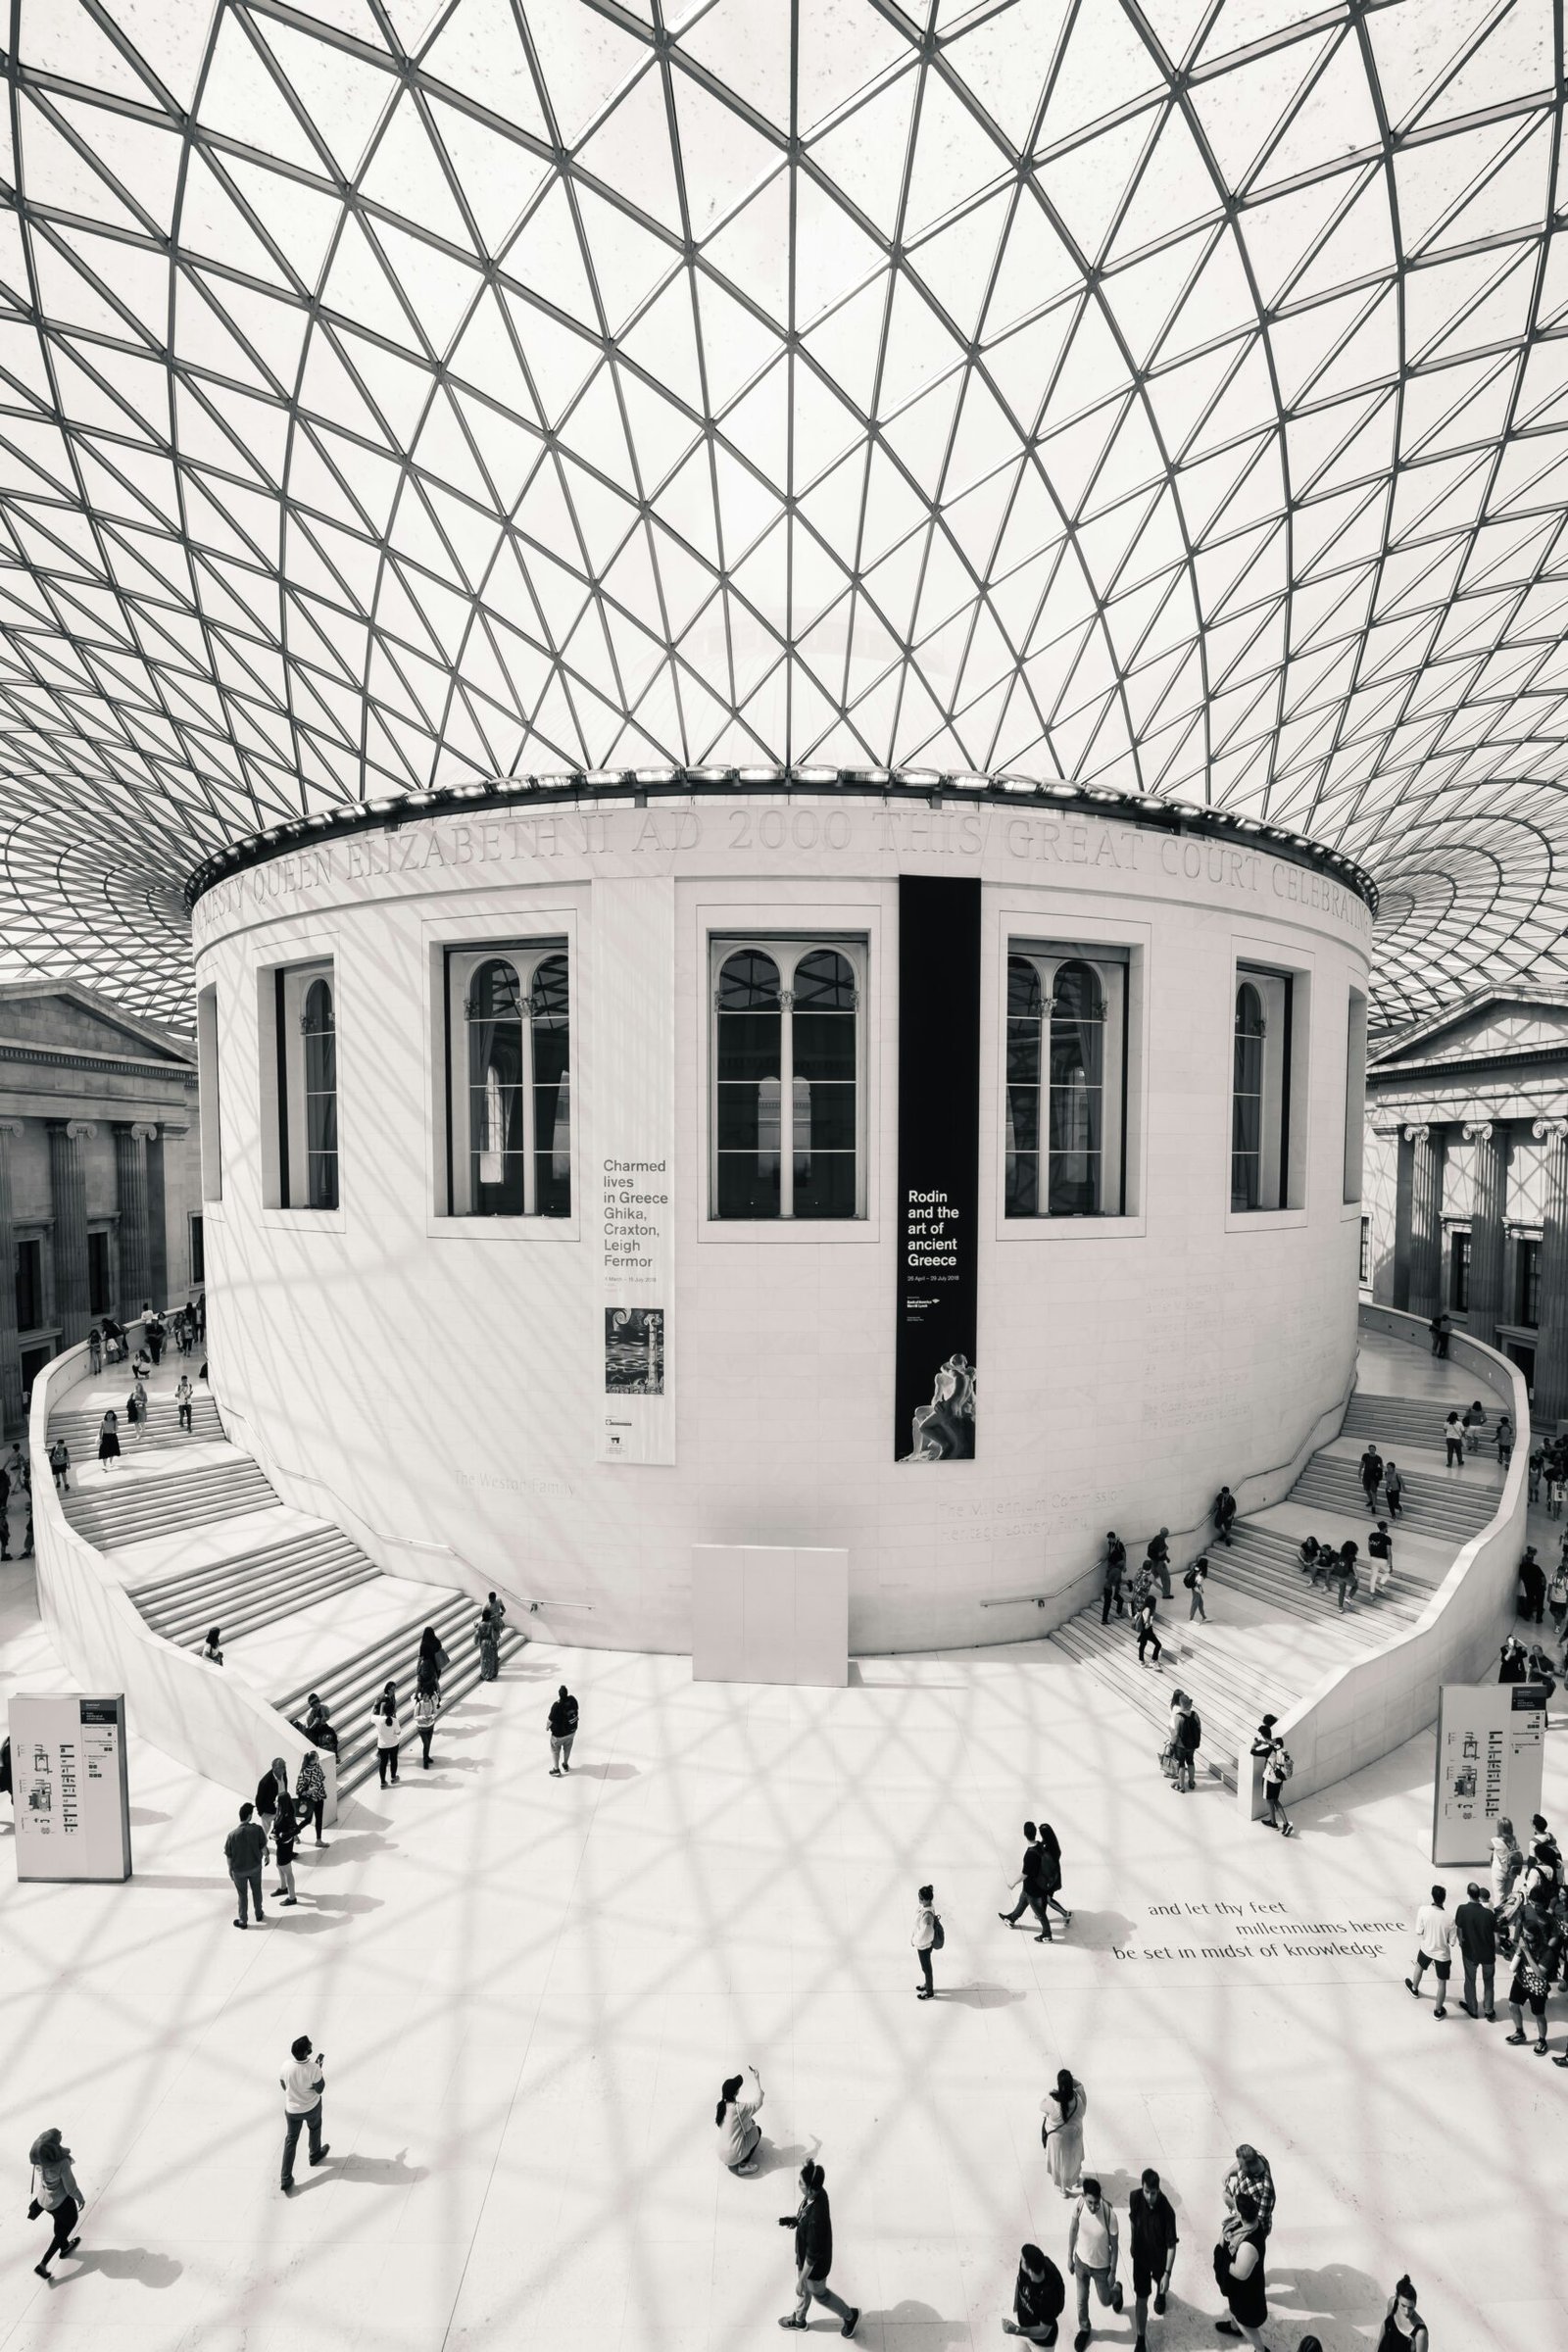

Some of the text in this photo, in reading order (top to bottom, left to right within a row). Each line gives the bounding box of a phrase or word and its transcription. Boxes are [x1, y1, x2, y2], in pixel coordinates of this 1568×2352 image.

[253, 847, 334, 906] QUEEN
[346, 815, 565, 881] ELIZABETH
[580, 813, 614, 856] II
[631, 810, 703, 854] AD
[727, 808, 854, 854] 2000
[871, 810, 984, 855] THIS
[1004, 818, 1147, 871] GREAT
[1158, 839, 1268, 893] COURT
[603, 1159, 666, 1172] Charmed
[604, 1175, 634, 1188] lives
[604, 1191, 668, 1204] in Greece
[908, 1190, 948, 1202] Rodin
[604, 1206, 648, 1222] Ghika,
[907, 1206, 959, 1219] and the
[604, 1222, 661, 1238] Craxton,
[907, 1222, 945, 1235] art of
[604, 1239, 641, 1253] Leigh
[907, 1238, 957, 1250] ancient
[604, 1254, 654, 1267] Fermor
[907, 1253, 957, 1266] Greece
[454, 1469, 475, 1486] The
[479, 1472, 527, 1491] Weston
[1149, 1900, 1289, 1917] and let thy feet
[1236, 1920, 1408, 1936] millenniums hence
[1112, 1941, 1388, 1960] be set in midst of knowledge
